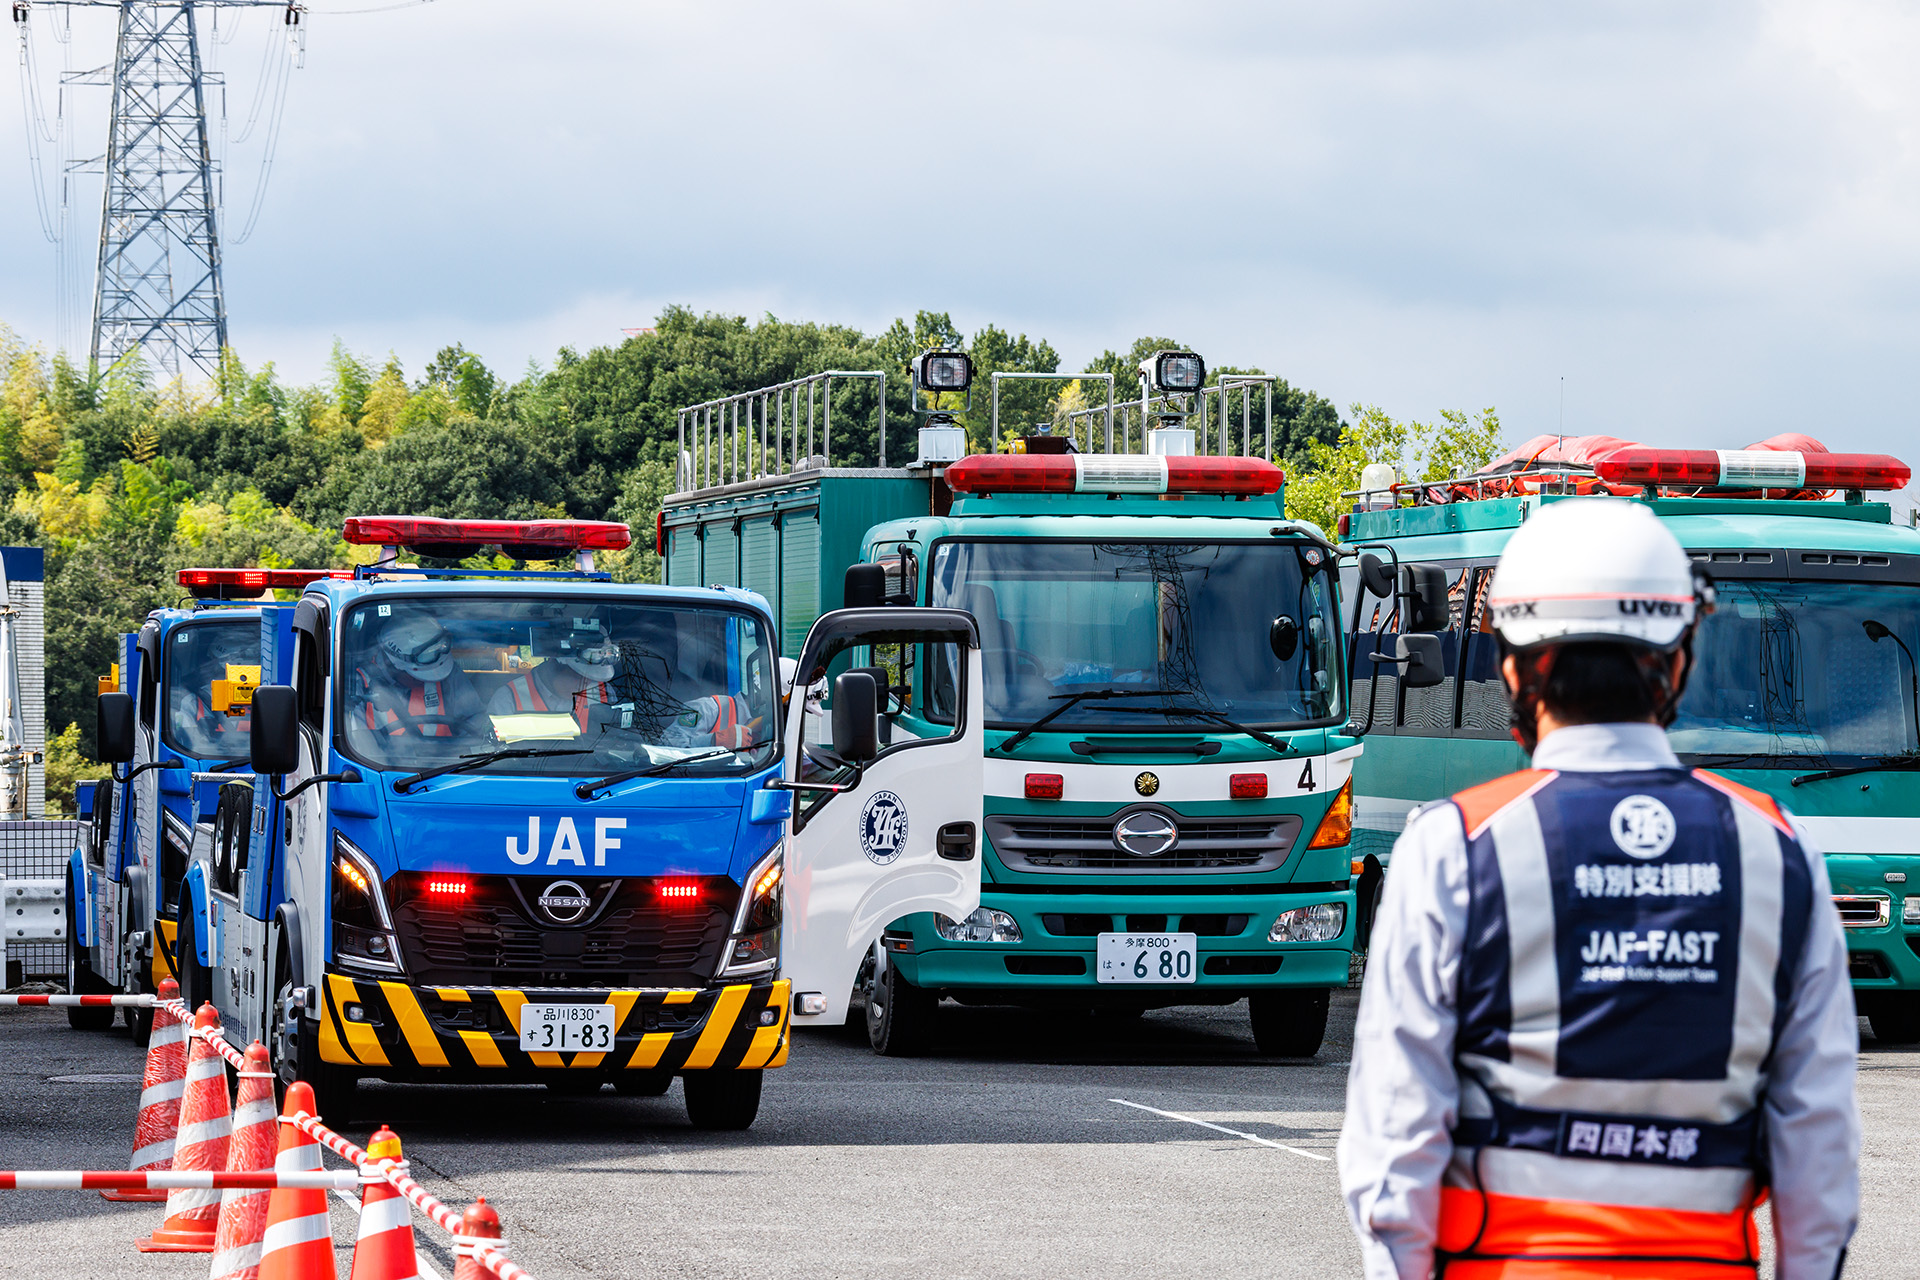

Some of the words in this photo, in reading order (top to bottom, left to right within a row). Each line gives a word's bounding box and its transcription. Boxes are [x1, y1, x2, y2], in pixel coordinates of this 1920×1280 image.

[1618, 600, 1685, 618] uvex
[387, 641, 402, 655] JAF
[1297, 758, 1317, 792] 4
[874, 792, 898, 803] JAPAN
[505, 815, 628, 867] JAF
[860, 810, 881, 863] FEDERATION
[886, 810, 907, 862] AUTOMOBILE
[1574, 862, 1722, 898] 特別支援隊
[539, 897, 590, 907] NISSAN
[1580, 930, 1720, 964] JAF-FAST
[541, 1023, 610, 1048] 31-83
[1567, 1120, 1701, 1162] 四国本部
